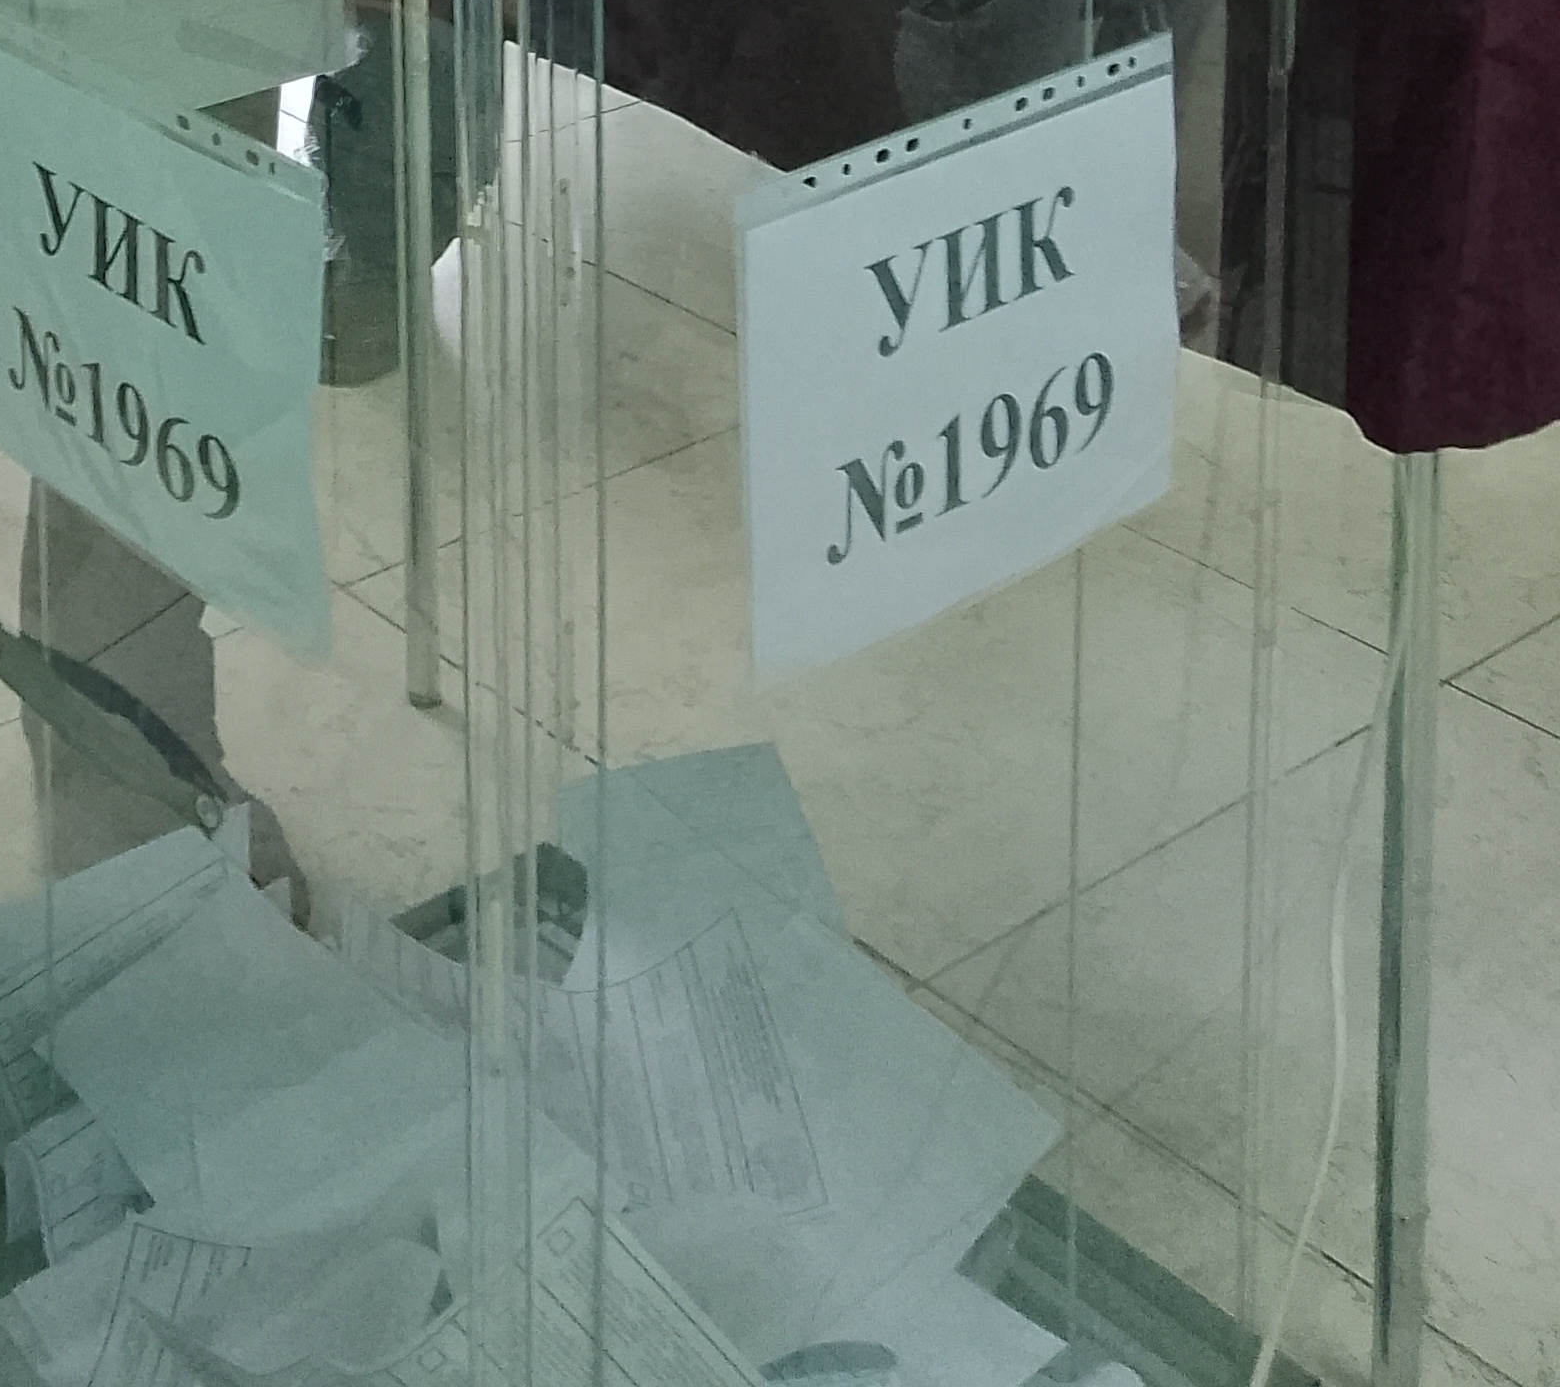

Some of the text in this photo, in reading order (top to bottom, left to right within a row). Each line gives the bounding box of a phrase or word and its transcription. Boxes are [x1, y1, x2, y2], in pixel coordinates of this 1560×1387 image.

[33, 161, 206, 345] УИК
[863, 185, 1076, 357] УИК
[7, 305, 241, 520] №1969
[825, 350, 1116, 566] №1969
